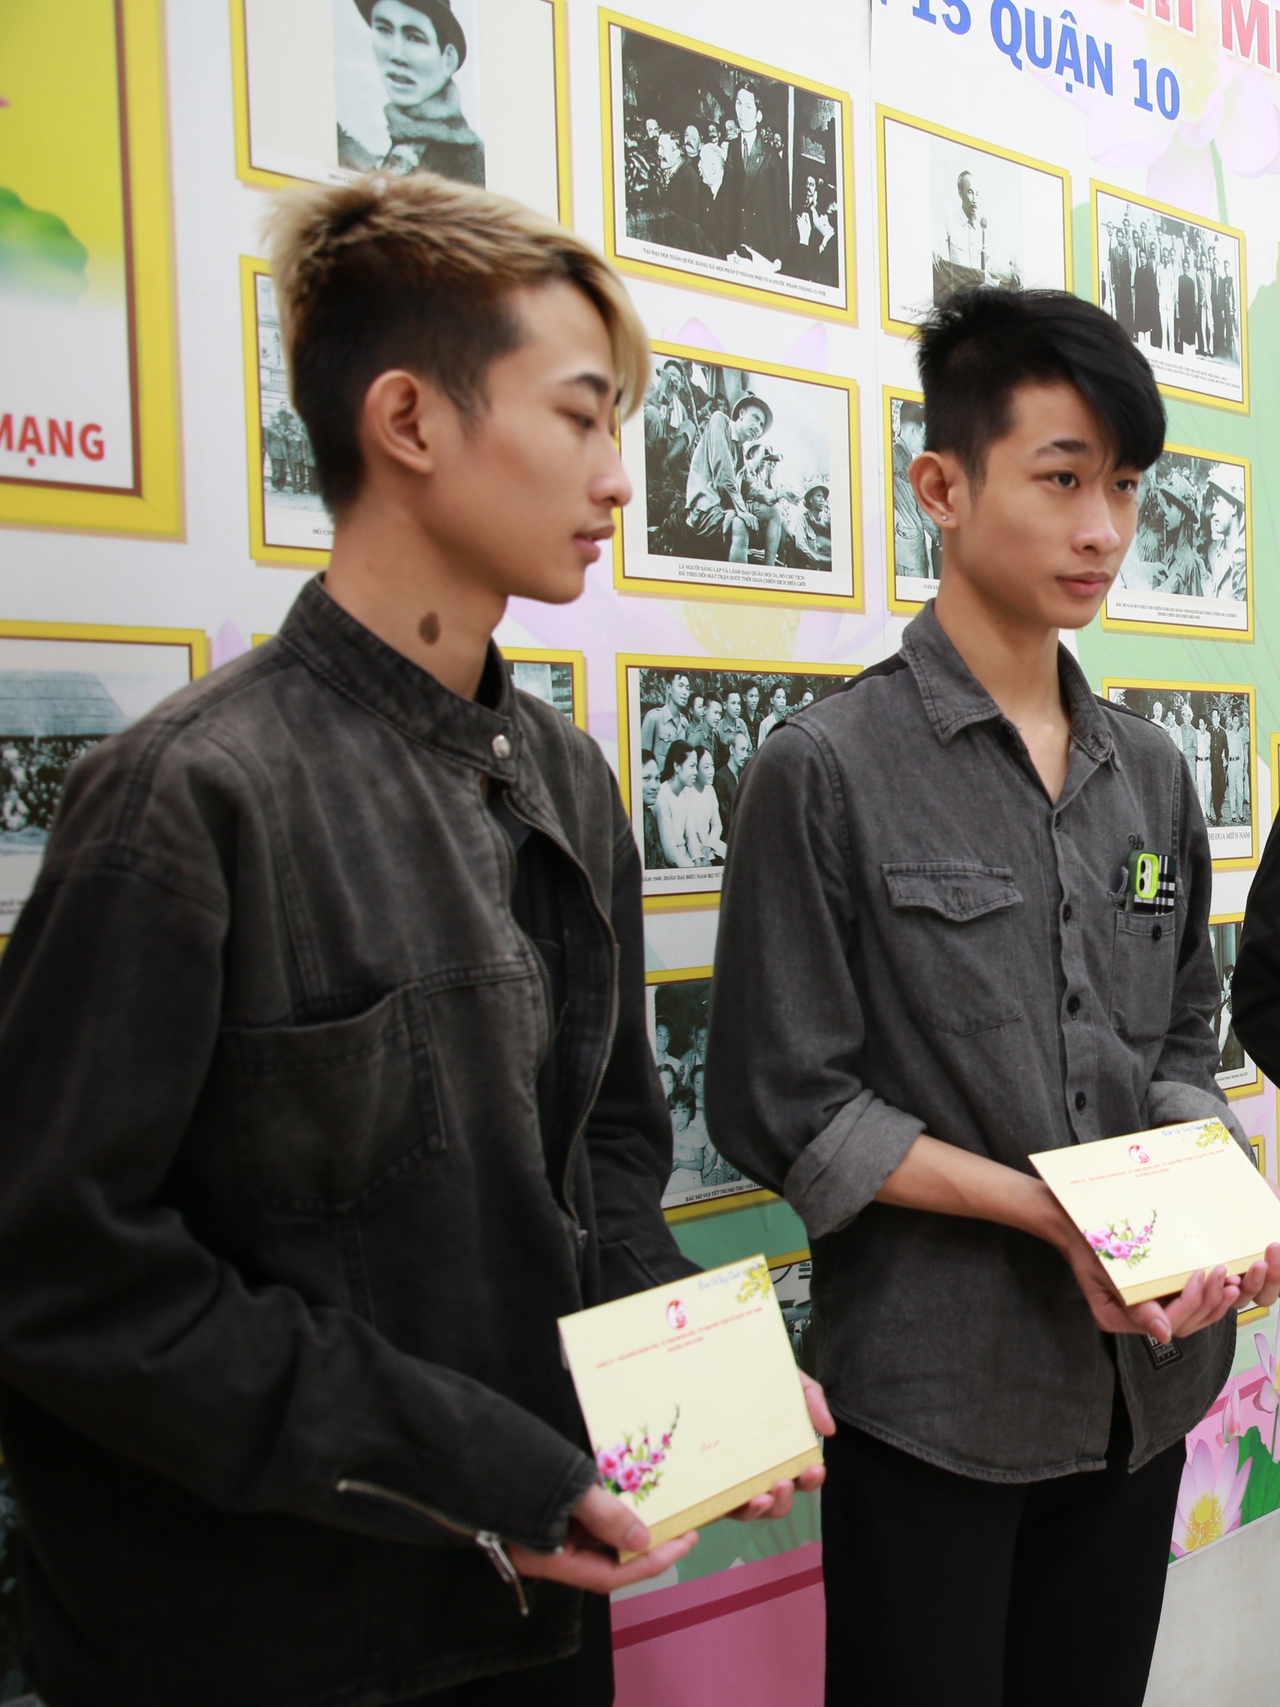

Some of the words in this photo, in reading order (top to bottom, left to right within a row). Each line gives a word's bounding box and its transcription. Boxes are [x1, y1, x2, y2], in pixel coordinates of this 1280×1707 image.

[990, 0, 1113, 97] QUẬN
[1133, 58, 1180, 121] 10
[1239, 831, 1250, 839] NAM
